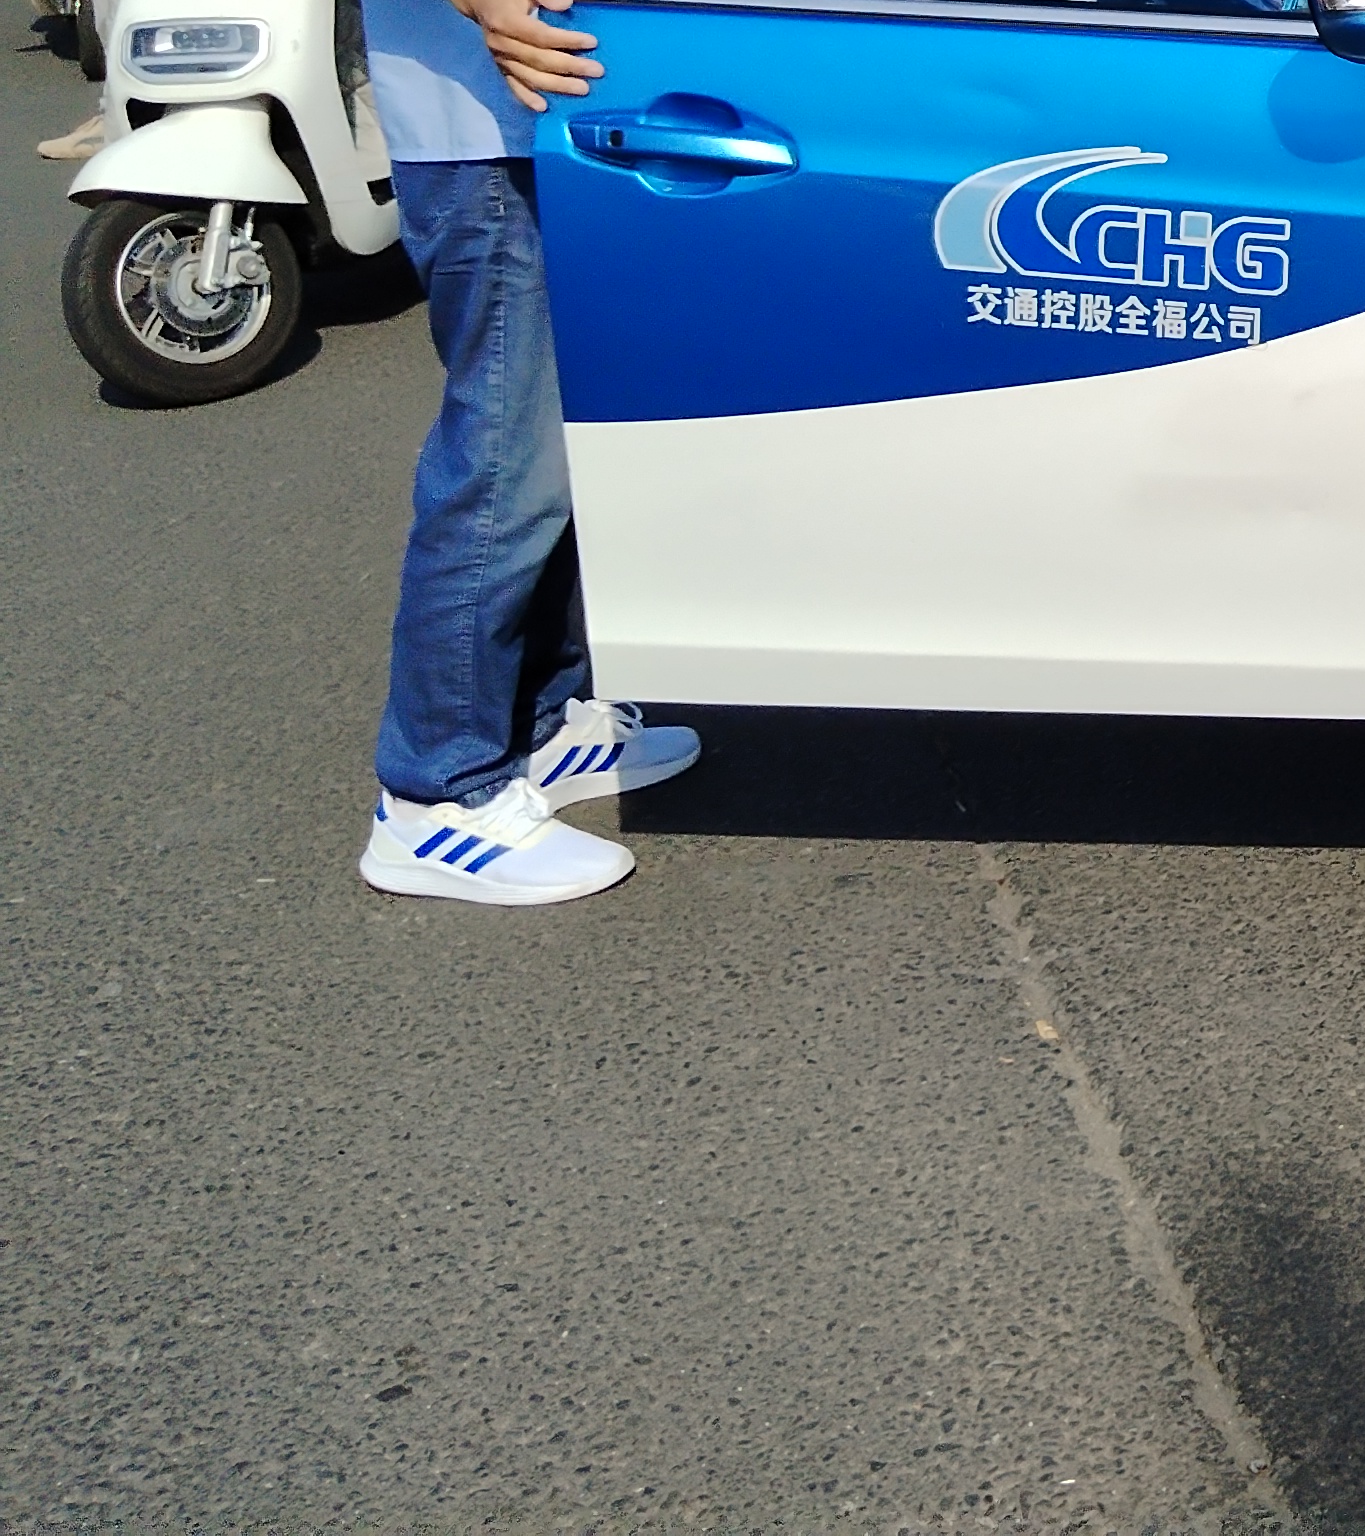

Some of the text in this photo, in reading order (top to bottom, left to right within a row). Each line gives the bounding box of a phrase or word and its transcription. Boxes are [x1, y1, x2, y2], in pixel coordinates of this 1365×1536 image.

[966, 283, 1262, 345] 交通控股全福公司
